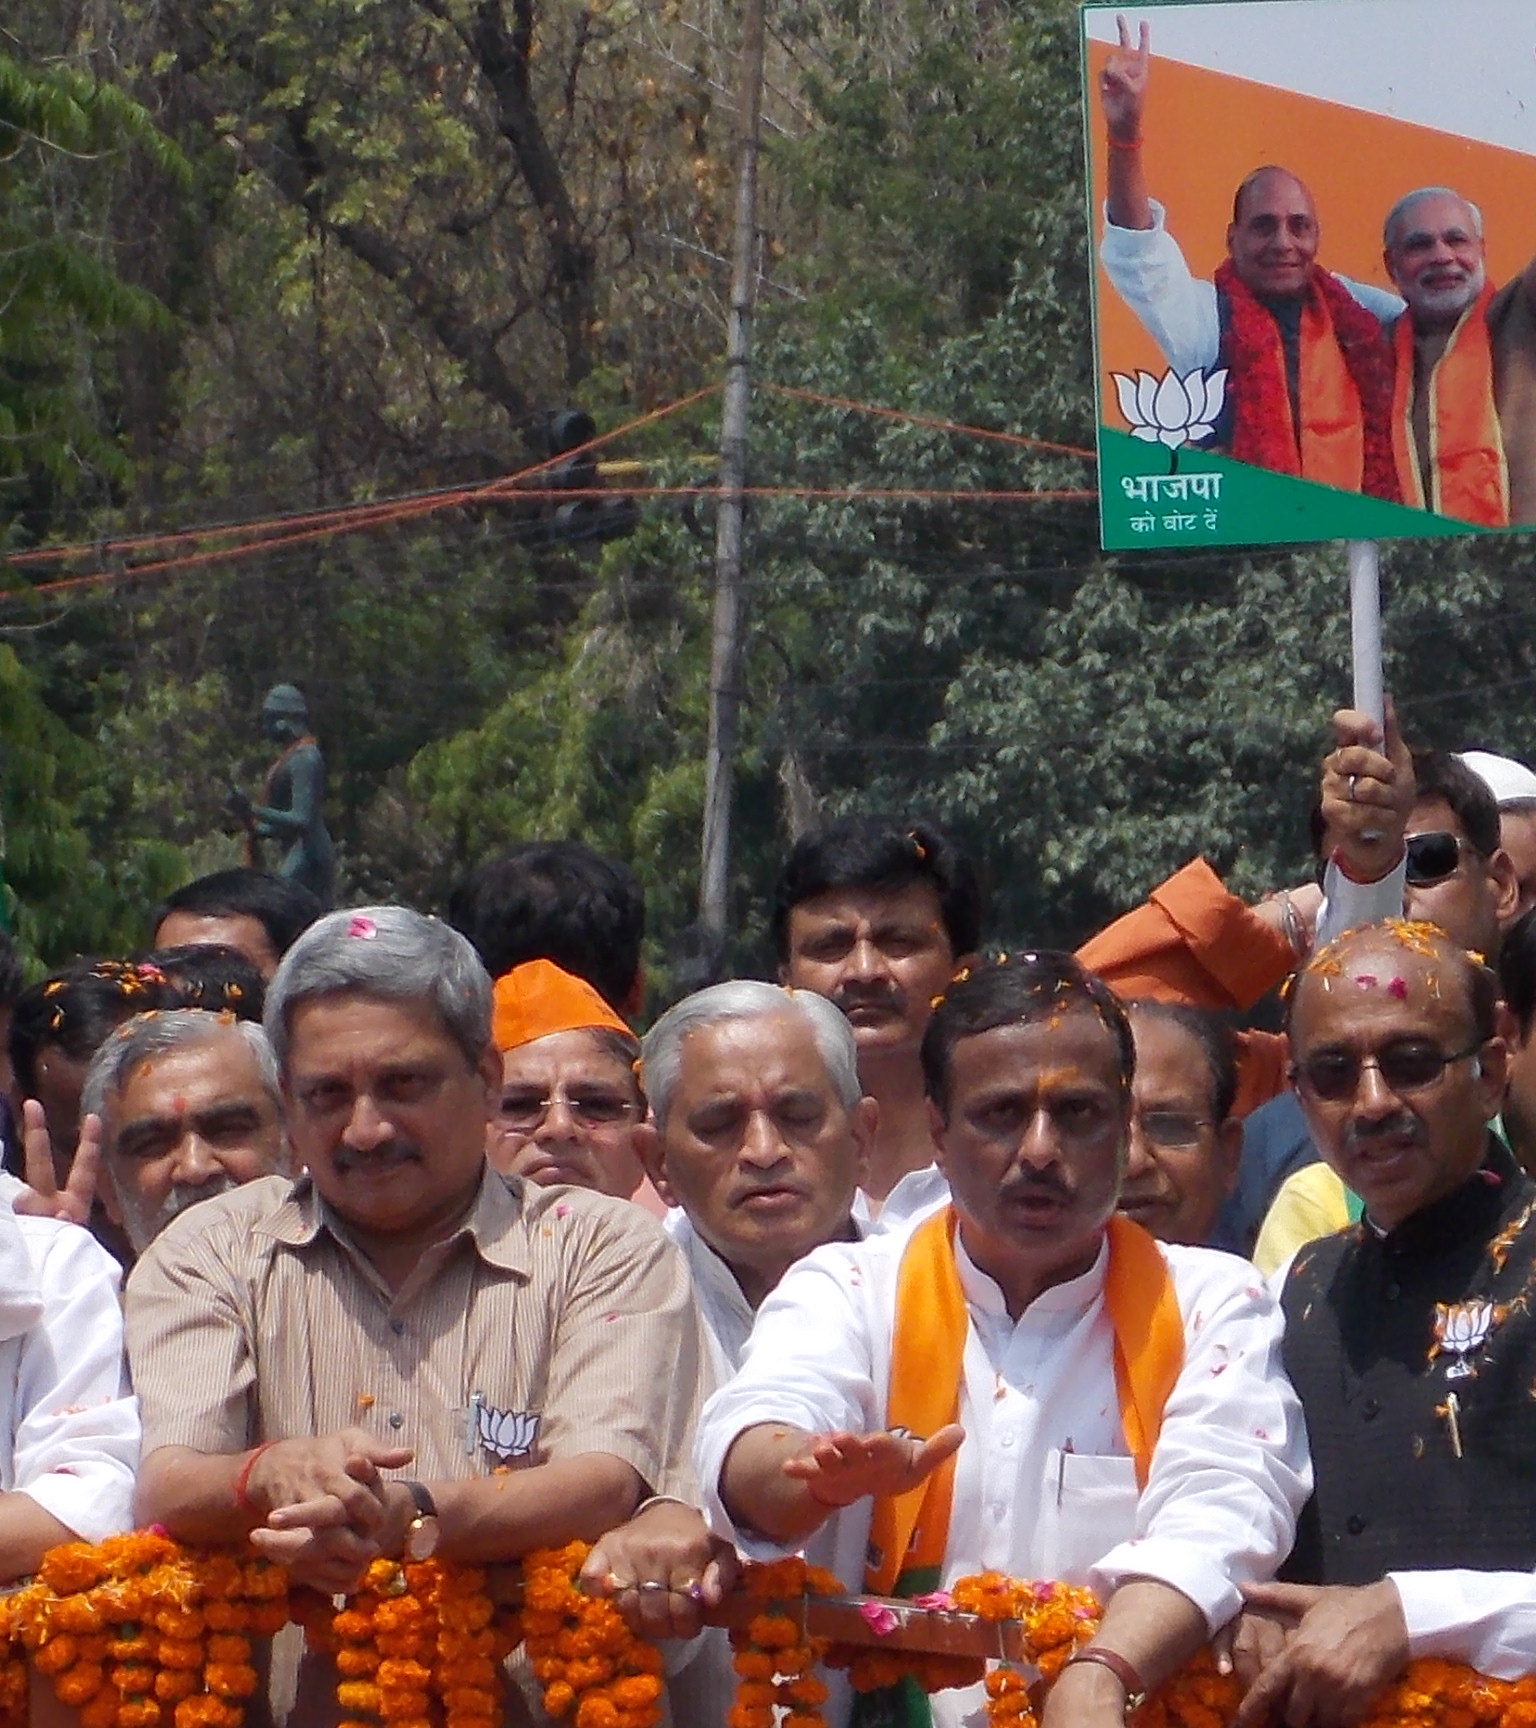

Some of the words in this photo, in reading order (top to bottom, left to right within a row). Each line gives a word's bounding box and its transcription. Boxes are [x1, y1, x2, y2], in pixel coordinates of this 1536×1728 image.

[1121, 473, 1223, 502] भाजपा
[1130, 510, 1156, 532] को
[1162, 508, 1197, 532] वोट
[1203, 507, 1218, 530] दें
